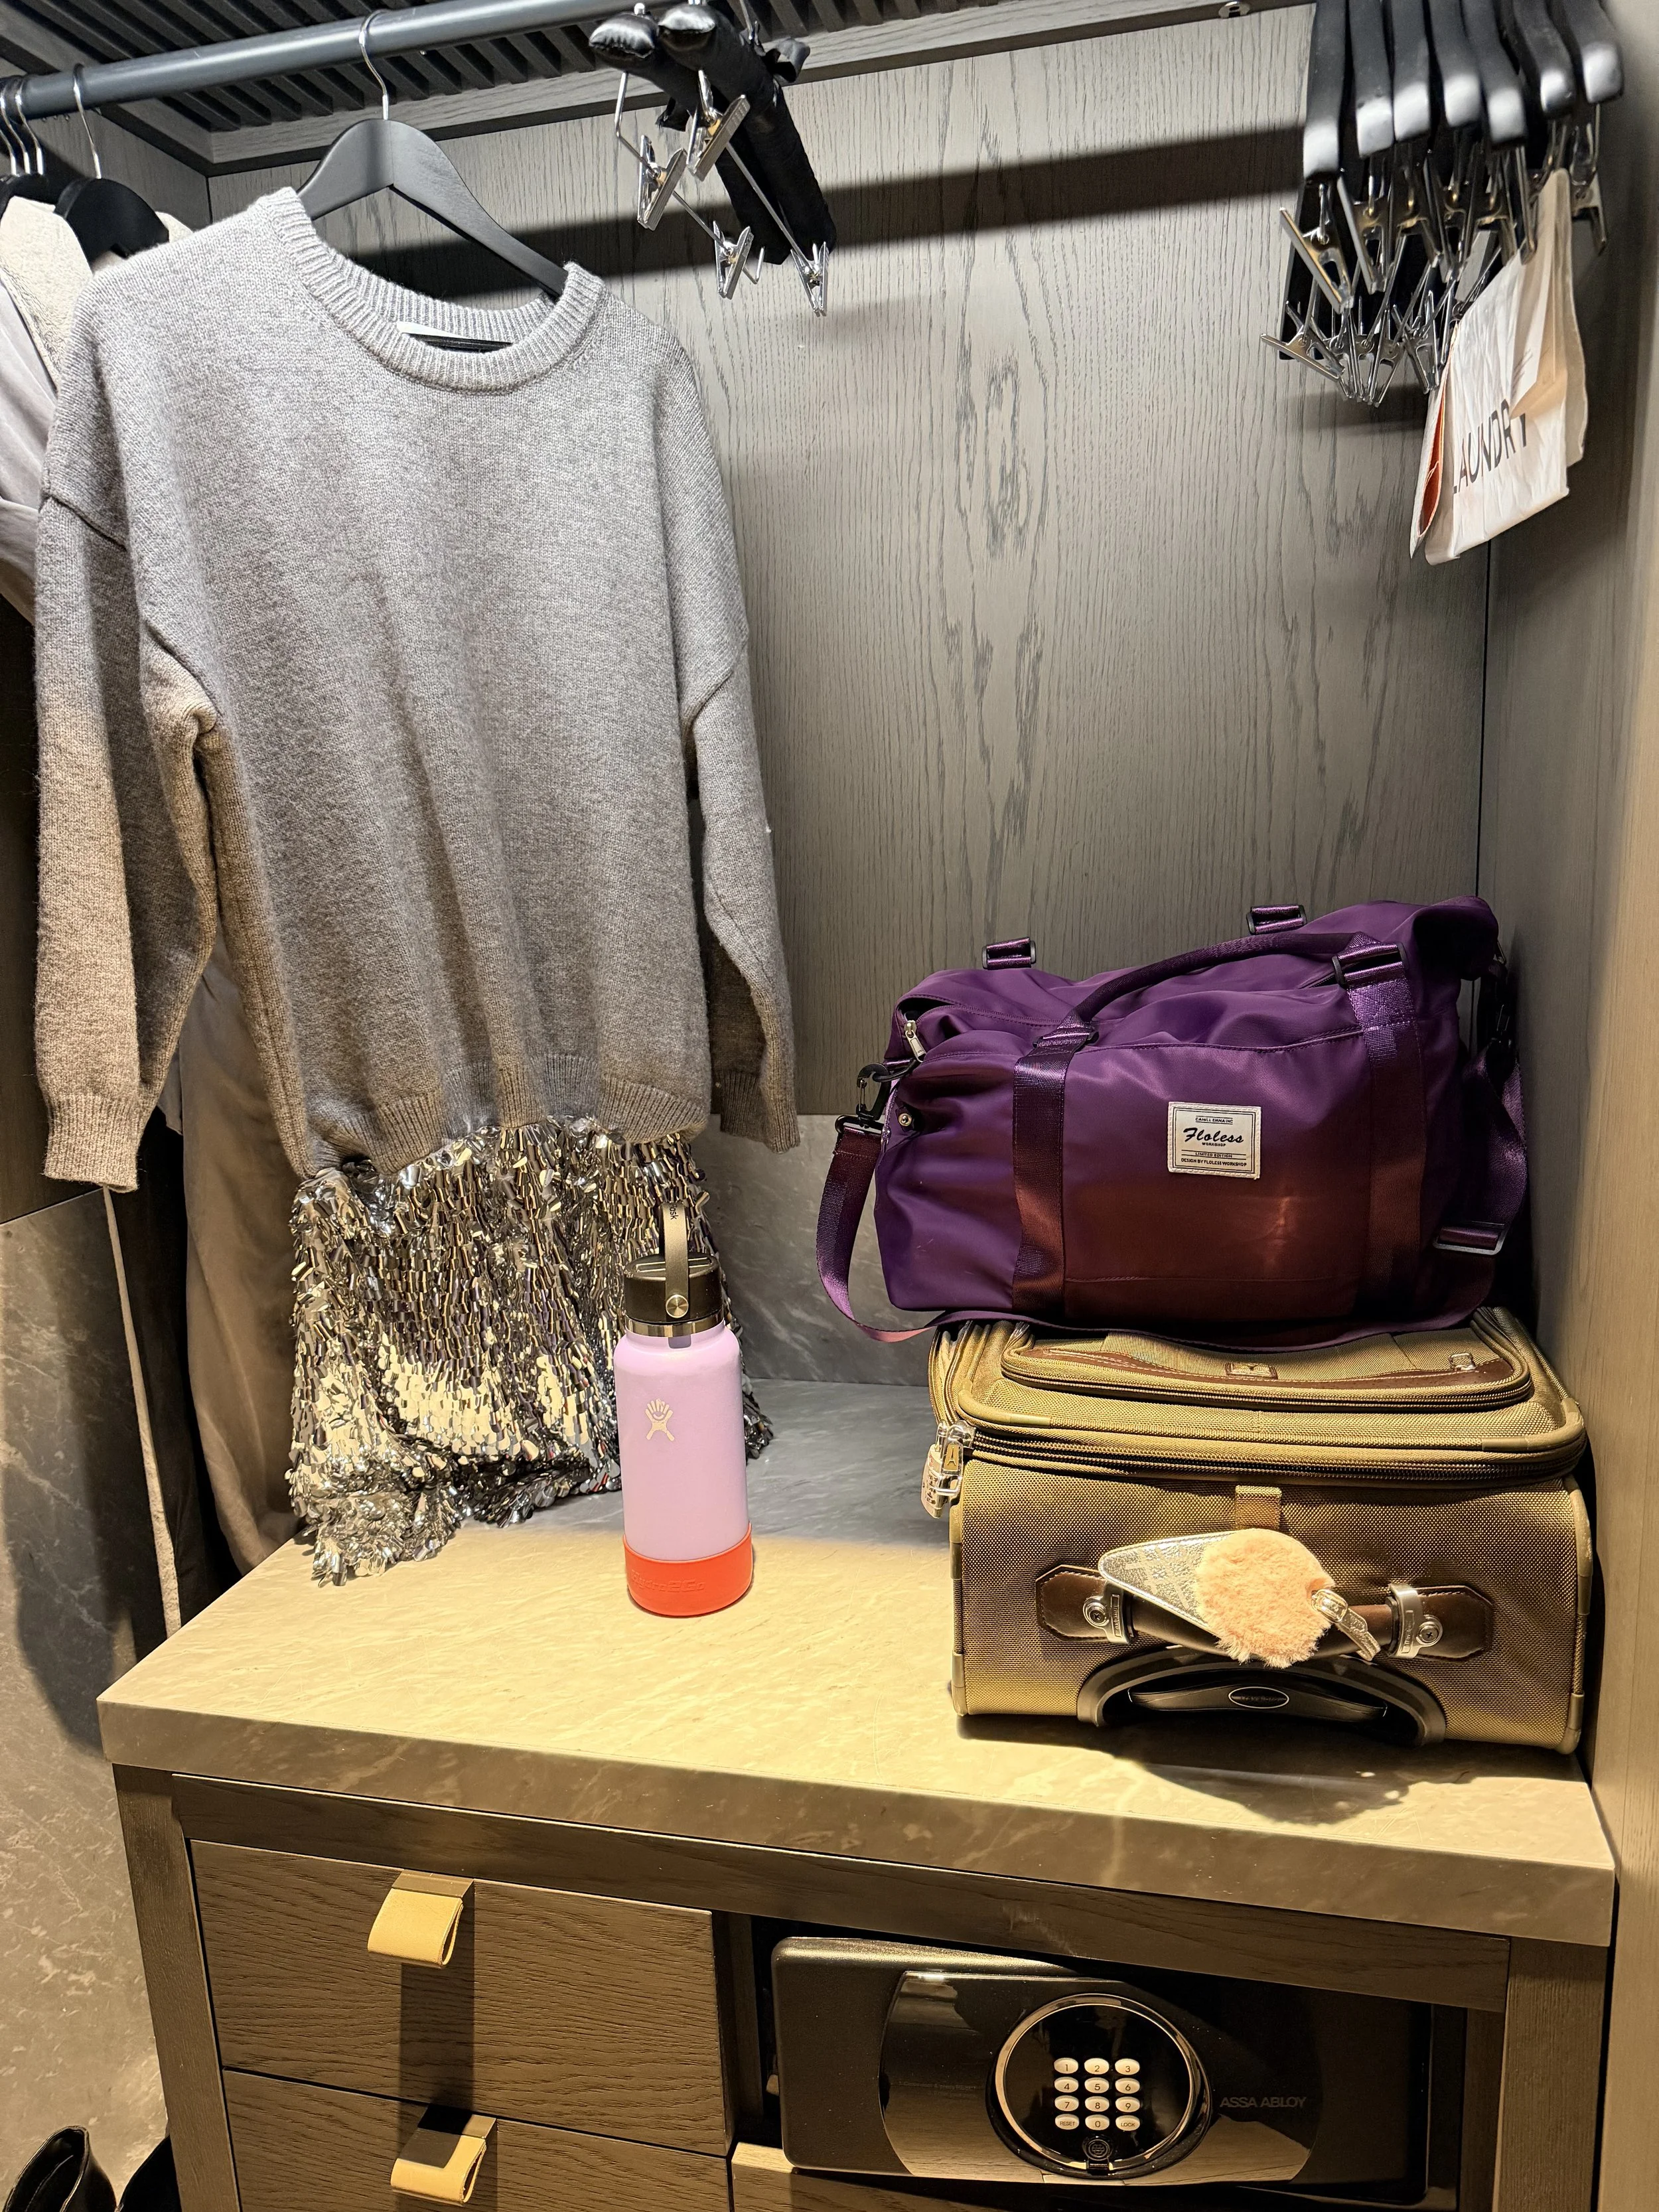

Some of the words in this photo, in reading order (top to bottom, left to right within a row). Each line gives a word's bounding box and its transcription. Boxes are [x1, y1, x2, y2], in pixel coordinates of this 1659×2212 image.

[1453, 399, 1527, 494] AUNDR
[1183, 1128, 1244, 1143] Floless
[1220, 2097, 1258, 2108] ASSA
[1260, 2097, 1307, 2108] ABLOY
